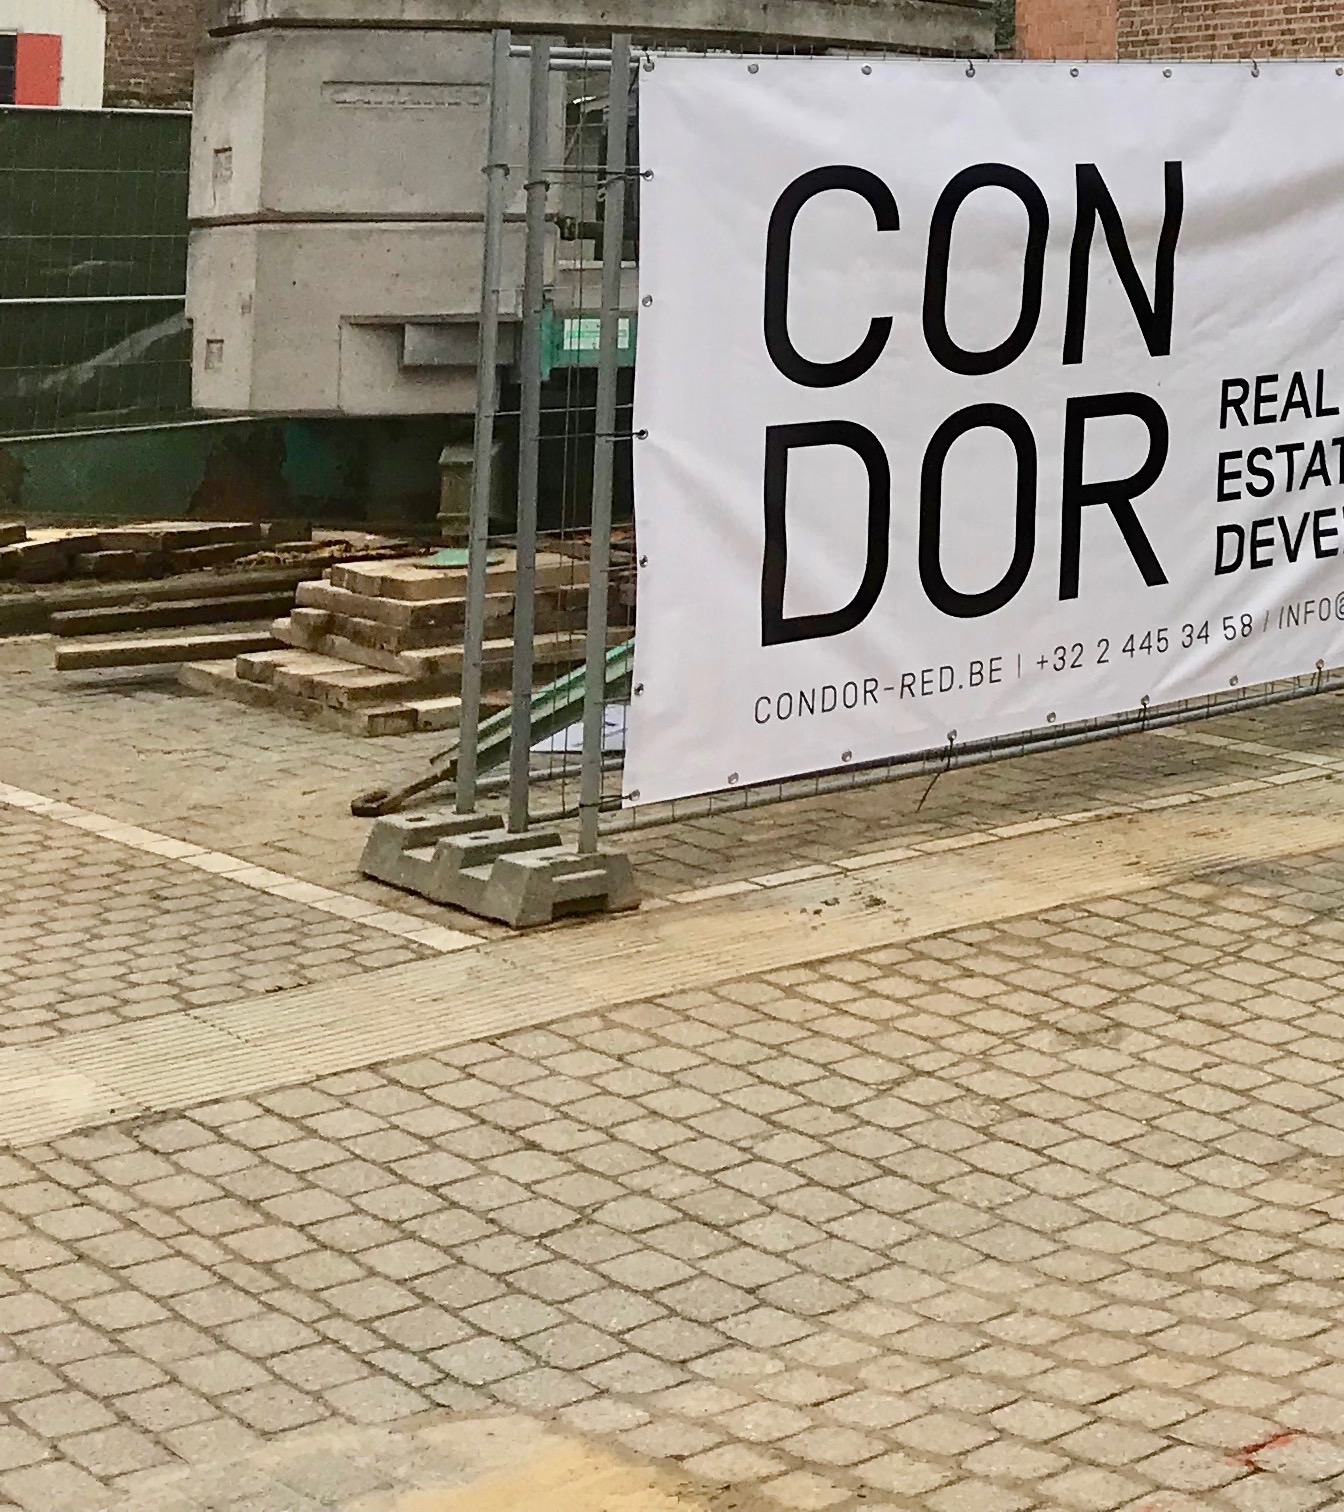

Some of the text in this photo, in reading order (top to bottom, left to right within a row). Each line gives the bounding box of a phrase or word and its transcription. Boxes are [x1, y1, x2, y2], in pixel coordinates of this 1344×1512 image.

[763, 160, 1184, 389] CON
[1219, 368, 1340, 430] REAL
[760, 391, 1169, 648] DOR
[754, 656, 1003, 724] CONDOR-RED.BE
[1036, 642, 1084, 672] +32
[1096, 638, 1110, 664] 2
[1121, 627, 1170, 658] 445
[1181, 620, 1210, 649] 34
[1223, 613, 1254, 642] 58
